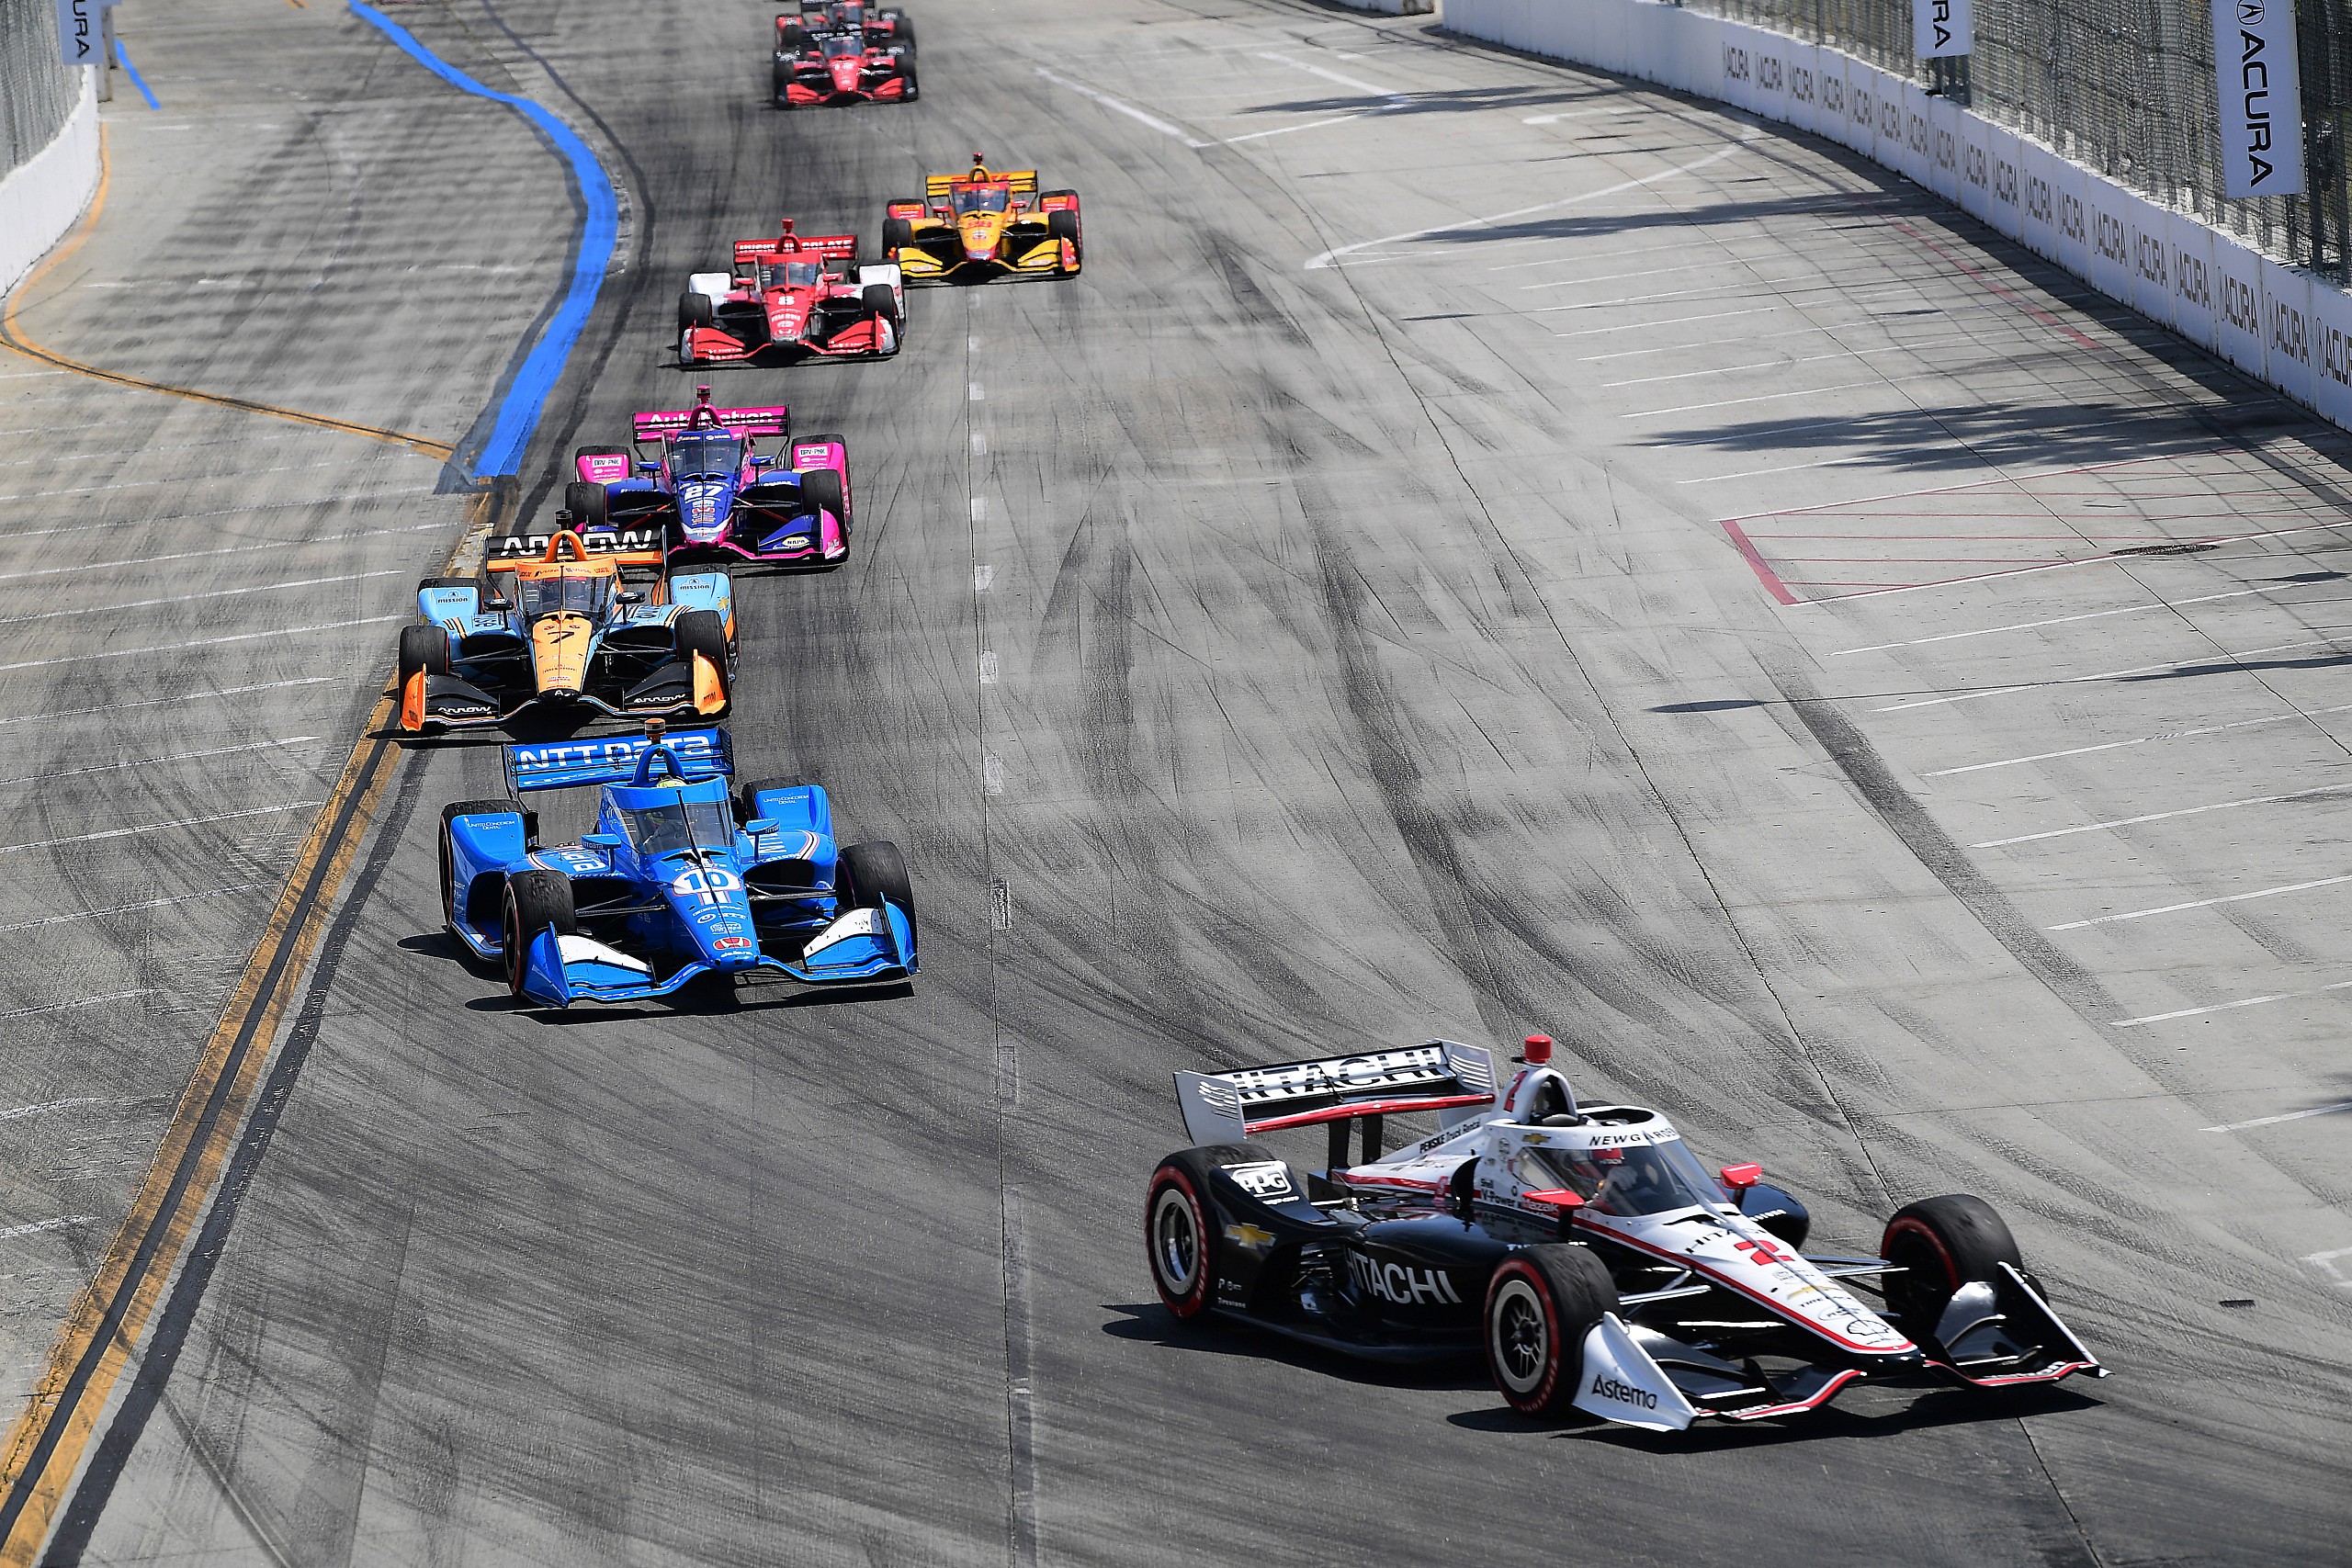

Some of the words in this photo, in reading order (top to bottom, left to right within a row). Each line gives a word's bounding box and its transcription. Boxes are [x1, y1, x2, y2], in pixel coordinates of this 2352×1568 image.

[2238, 28, 2274, 188] ACURA
[2029, 175, 2053, 226] ACURA
[2062, 192, 2086, 245] ACURA
[2098, 211, 2128, 266] ACURA
[2139, 231, 2168, 288] ACURA
[2179, 250, 2211, 310] ACURA
[777, 295, 795, 305] 8
[2225, 274, 2259, 338] ACURA
[2276, 299, 2311, 367] ACURA
[648, 410, 773, 428] AutNation
[684, 484, 724, 501] 27
[501, 530, 653, 556] AROW
[547, 630, 575, 645] 7
[520, 745, 599, 770] NTT
[684, 872, 729, 891] 10
[1503, 1070, 1529, 1112] 2
[1419, 1133, 1445, 1155] PENSKE
[1239, 1169, 1285, 1195] PPG
[1480, 1178, 1494, 1189] Shell
[1481, 1188, 1516, 1208] V-Power
[1734, 1239, 1796, 1266] 2
[1344, 1247, 1464, 1304] HITACHI
[1590, 1373, 1657, 1411] Astemo
